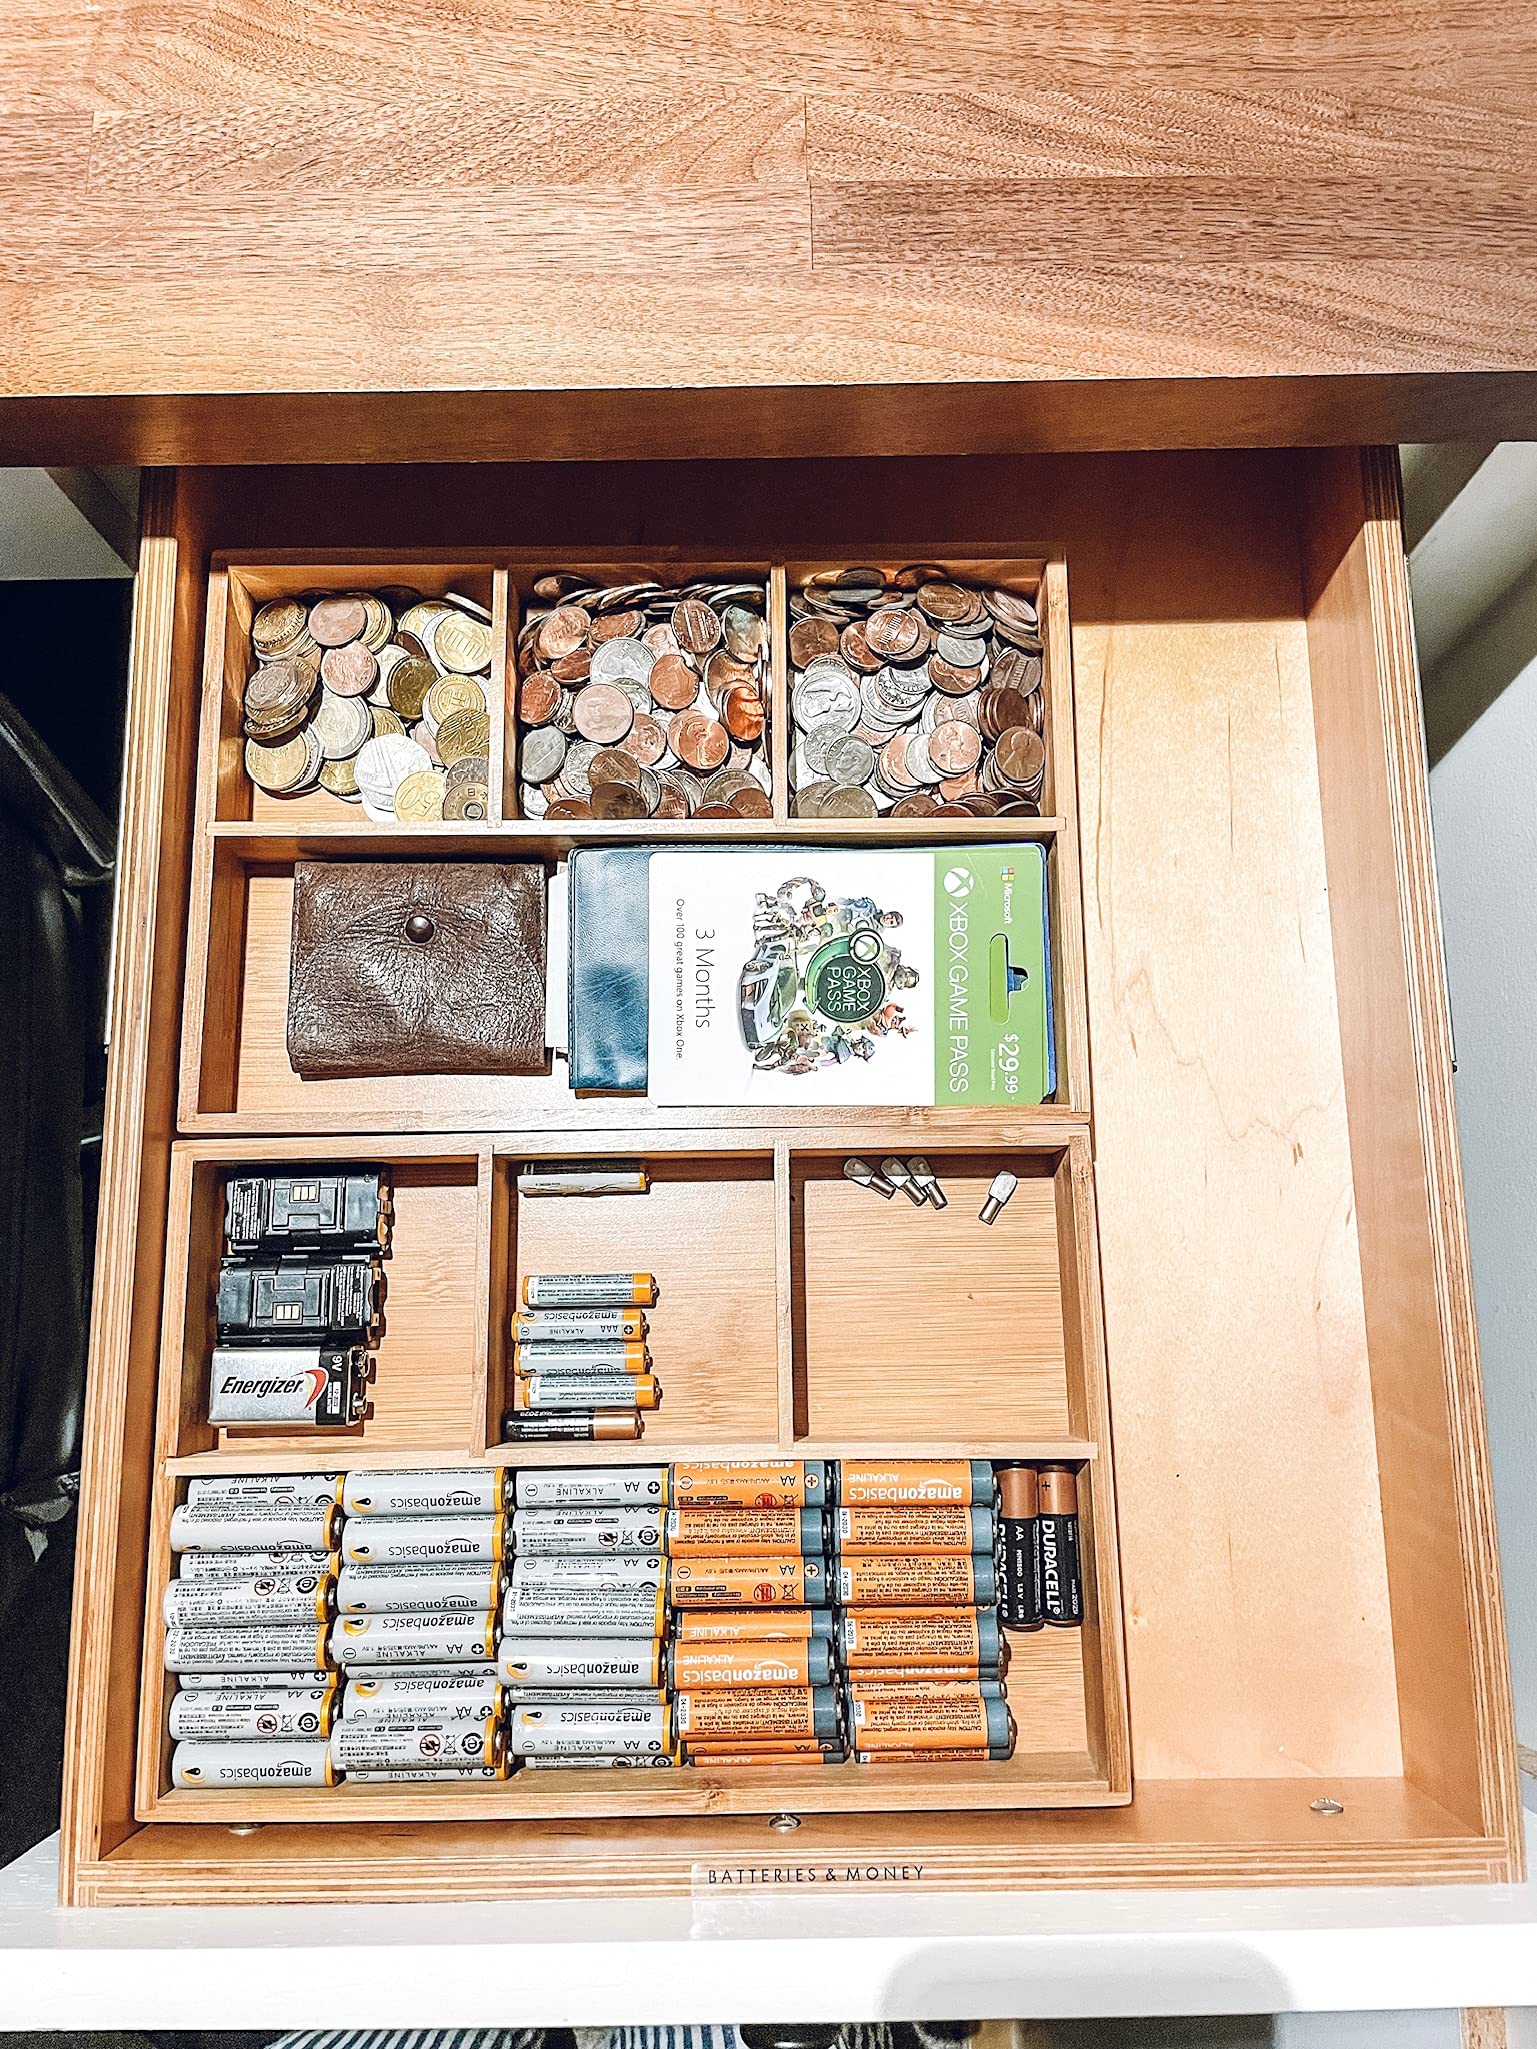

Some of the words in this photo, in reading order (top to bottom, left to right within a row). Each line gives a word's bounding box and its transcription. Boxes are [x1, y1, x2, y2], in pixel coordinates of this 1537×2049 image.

[676, 898, 685, 921] Over
[1003, 883, 1015, 925] Microsoft
[676, 924, 685, 939] 100
[696, 928, 716, 940] 3
[949, 901, 969, 963] XBOX
[674, 941, 685, 965] great
[674, 967, 684, 997] games
[696, 949, 716, 1029] Months
[827, 966, 842, 1012] PASS
[842, 966, 857, 1012] GAME
[856, 966, 872, 1012] XBOX
[949, 965, 969, 1031] GAME
[676, 999, 684, 1012] on
[676, 1013, 685, 1037] Xbox
[949, 1036, 969, 1093] PASS
[997, 1033, 1020, 1094] $29.99
[544, 1311, 618, 1322] amazonbasics
[600, 1325, 618, 1333] AAA
[332, 1355, 343, 1372] 9V
[219, 1376, 305, 1399] Energizer
[682, 1461, 795, 1473] amazonbasics
[779, 1476, 797, 1486] AA
[849, 1473, 899, 1483] ALKALINE
[556, 1487, 604, 1496] ALKALINE
[624, 1482, 640, 1492] AA
[849, 1487, 962, 1503] amazonbasics
[390, 1496, 482, 1510] amazonbasics
[1016, 1525, 1024, 1541] AA
[388, 1544, 480, 1558] amazonbasics
[623, 1559, 639, 1567] AA
[779, 1565, 796, 1575] AA
[1042, 1519, 1060, 1610] DURACELL
[385, 1600, 478, 1611] amazonbasics
[382, 1616, 475, 1631] amazonbasics
[690, 1626, 740, 1637] ALKALINE
[446, 1644, 463, 1653] AA
[683, 1654, 734, 1664] ALKALINE
[546, 1663, 639, 1677] amazonbasics
[682, 1668, 798, 1684] amazonbasics
[393, 1678, 485, 1693] amazonbasics
[215, 1694, 266, 1702] ALKALINE
[287, 1690, 305, 1698] AA
[560, 1712, 652, 1726] amazonbasics
[624, 1740, 640, 1750] AA
[219, 1767, 312, 1781] amazonbasics
[708, 1867, 817, 1884] BATTERIES
[825, 1868, 837, 1881] &
[846, 1865, 924, 1882] MONEY
